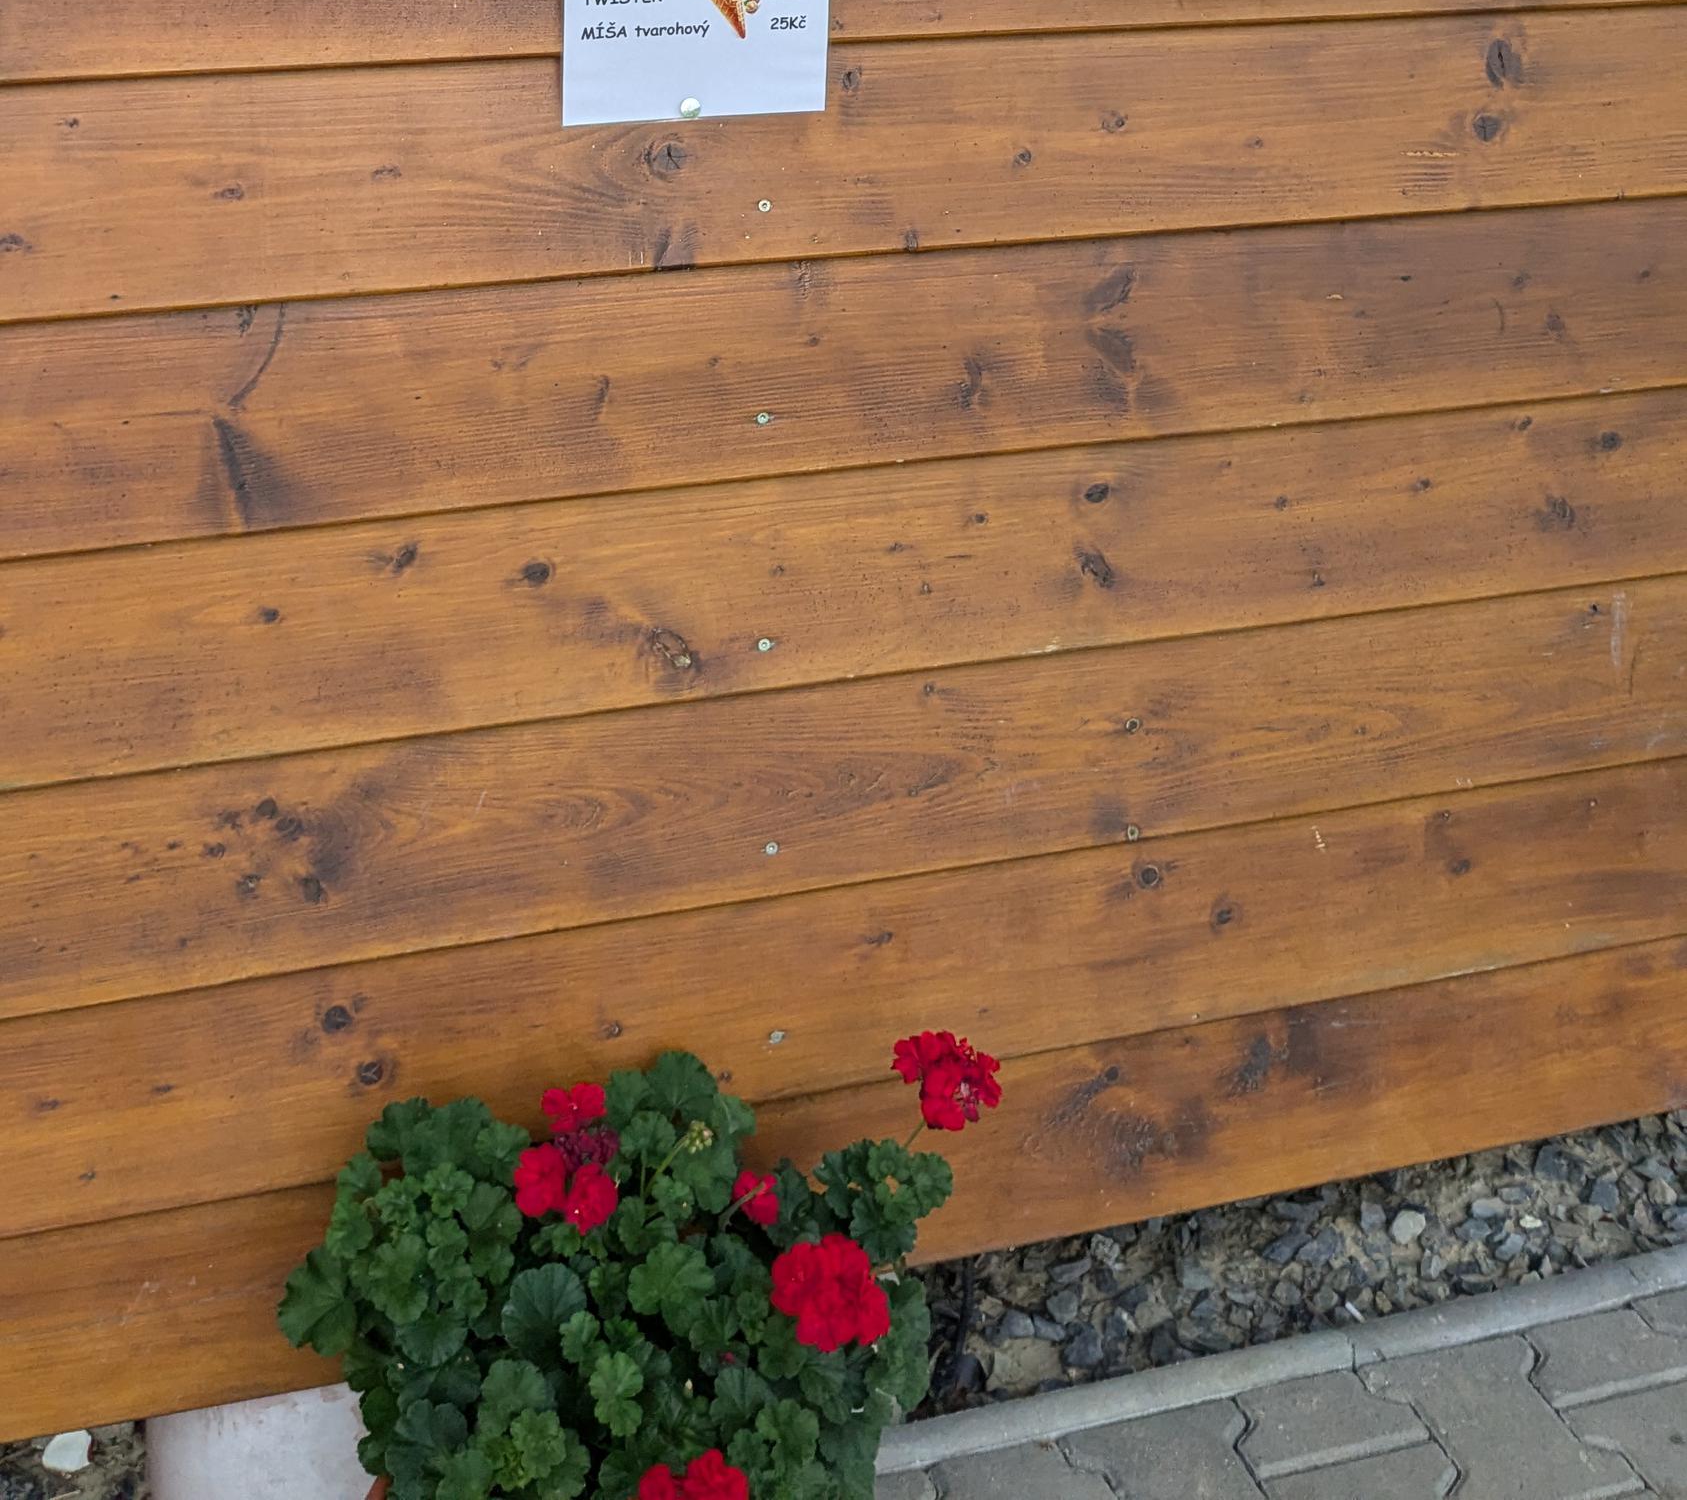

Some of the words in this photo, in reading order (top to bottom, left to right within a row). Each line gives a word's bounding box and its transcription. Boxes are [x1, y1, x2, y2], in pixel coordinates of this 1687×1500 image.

[581, 21, 627, 40] MÍŠA
[635, 19, 711, 38] tvarohový
[770, 15, 807, 30] 25Kč
